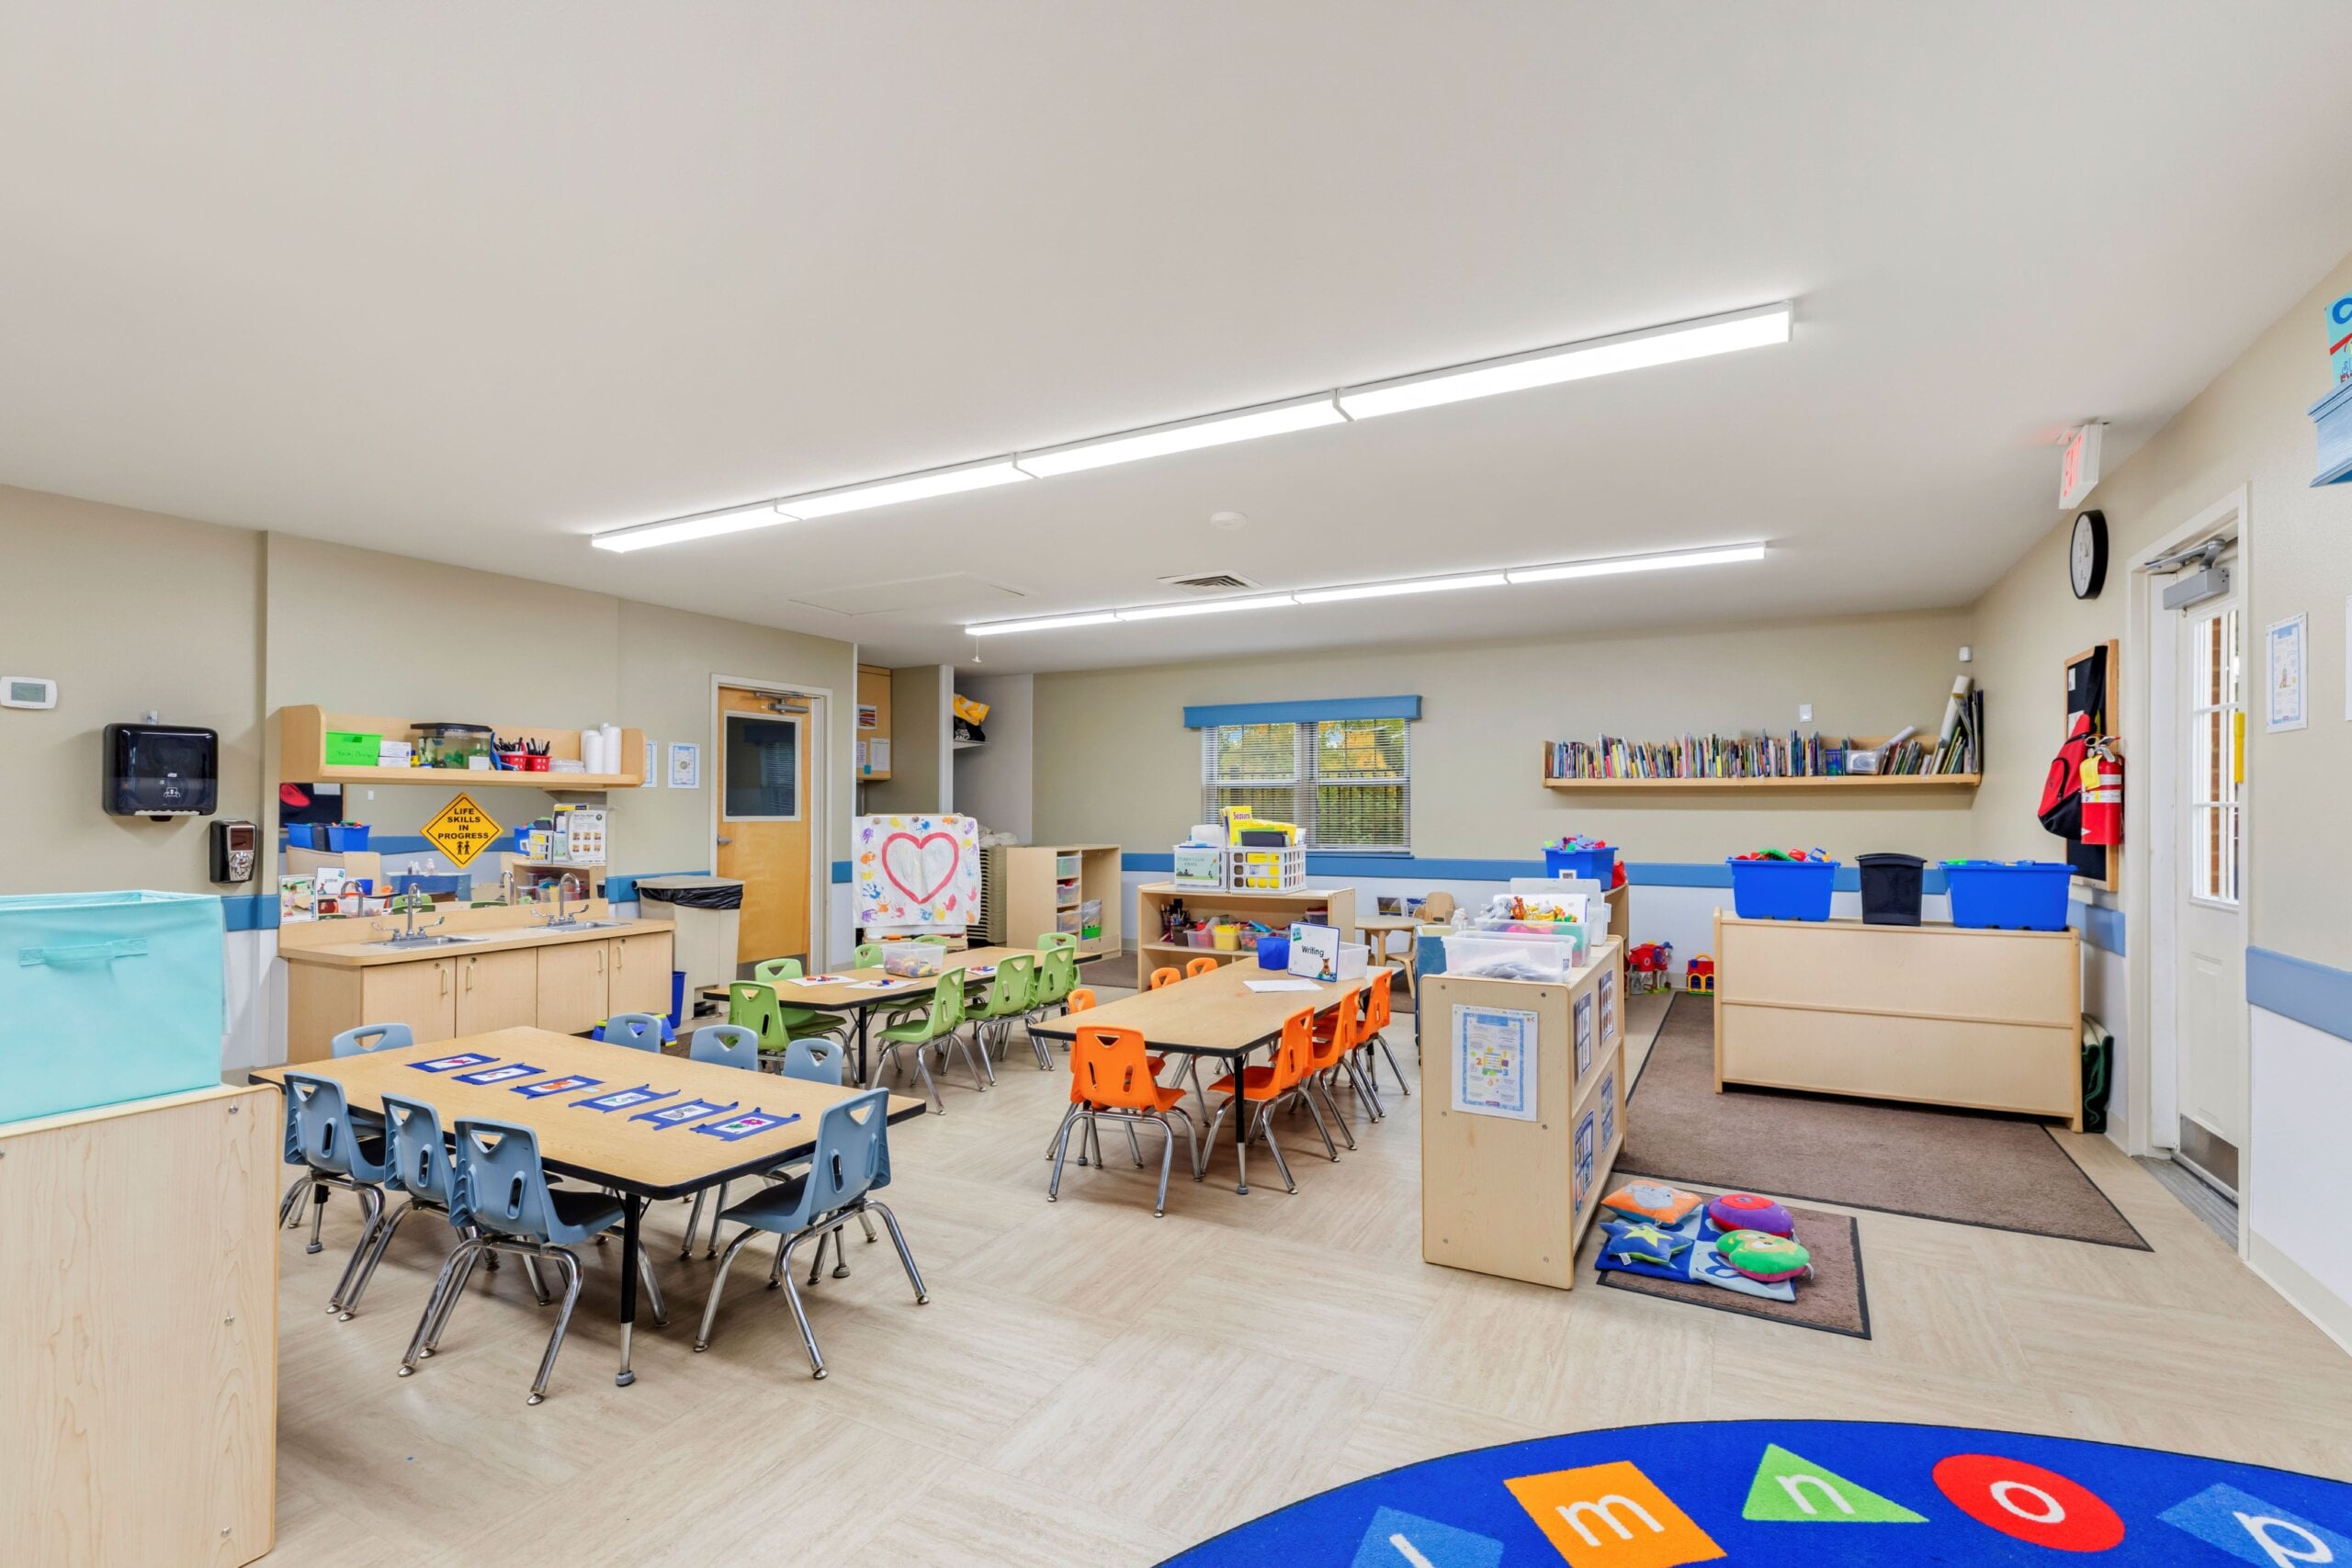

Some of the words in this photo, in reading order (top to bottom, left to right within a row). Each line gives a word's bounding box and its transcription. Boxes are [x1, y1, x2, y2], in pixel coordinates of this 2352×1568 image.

[1301, 945, 1325, 958] Writing
[1476, 1057, 1483, 1066] 2
[1555, 1494, 1665, 1547] m
[1776, 1474, 1855, 1515] n
[1990, 1480, 2066, 1524] o
[2233, 1511, 2334, 1568] p
